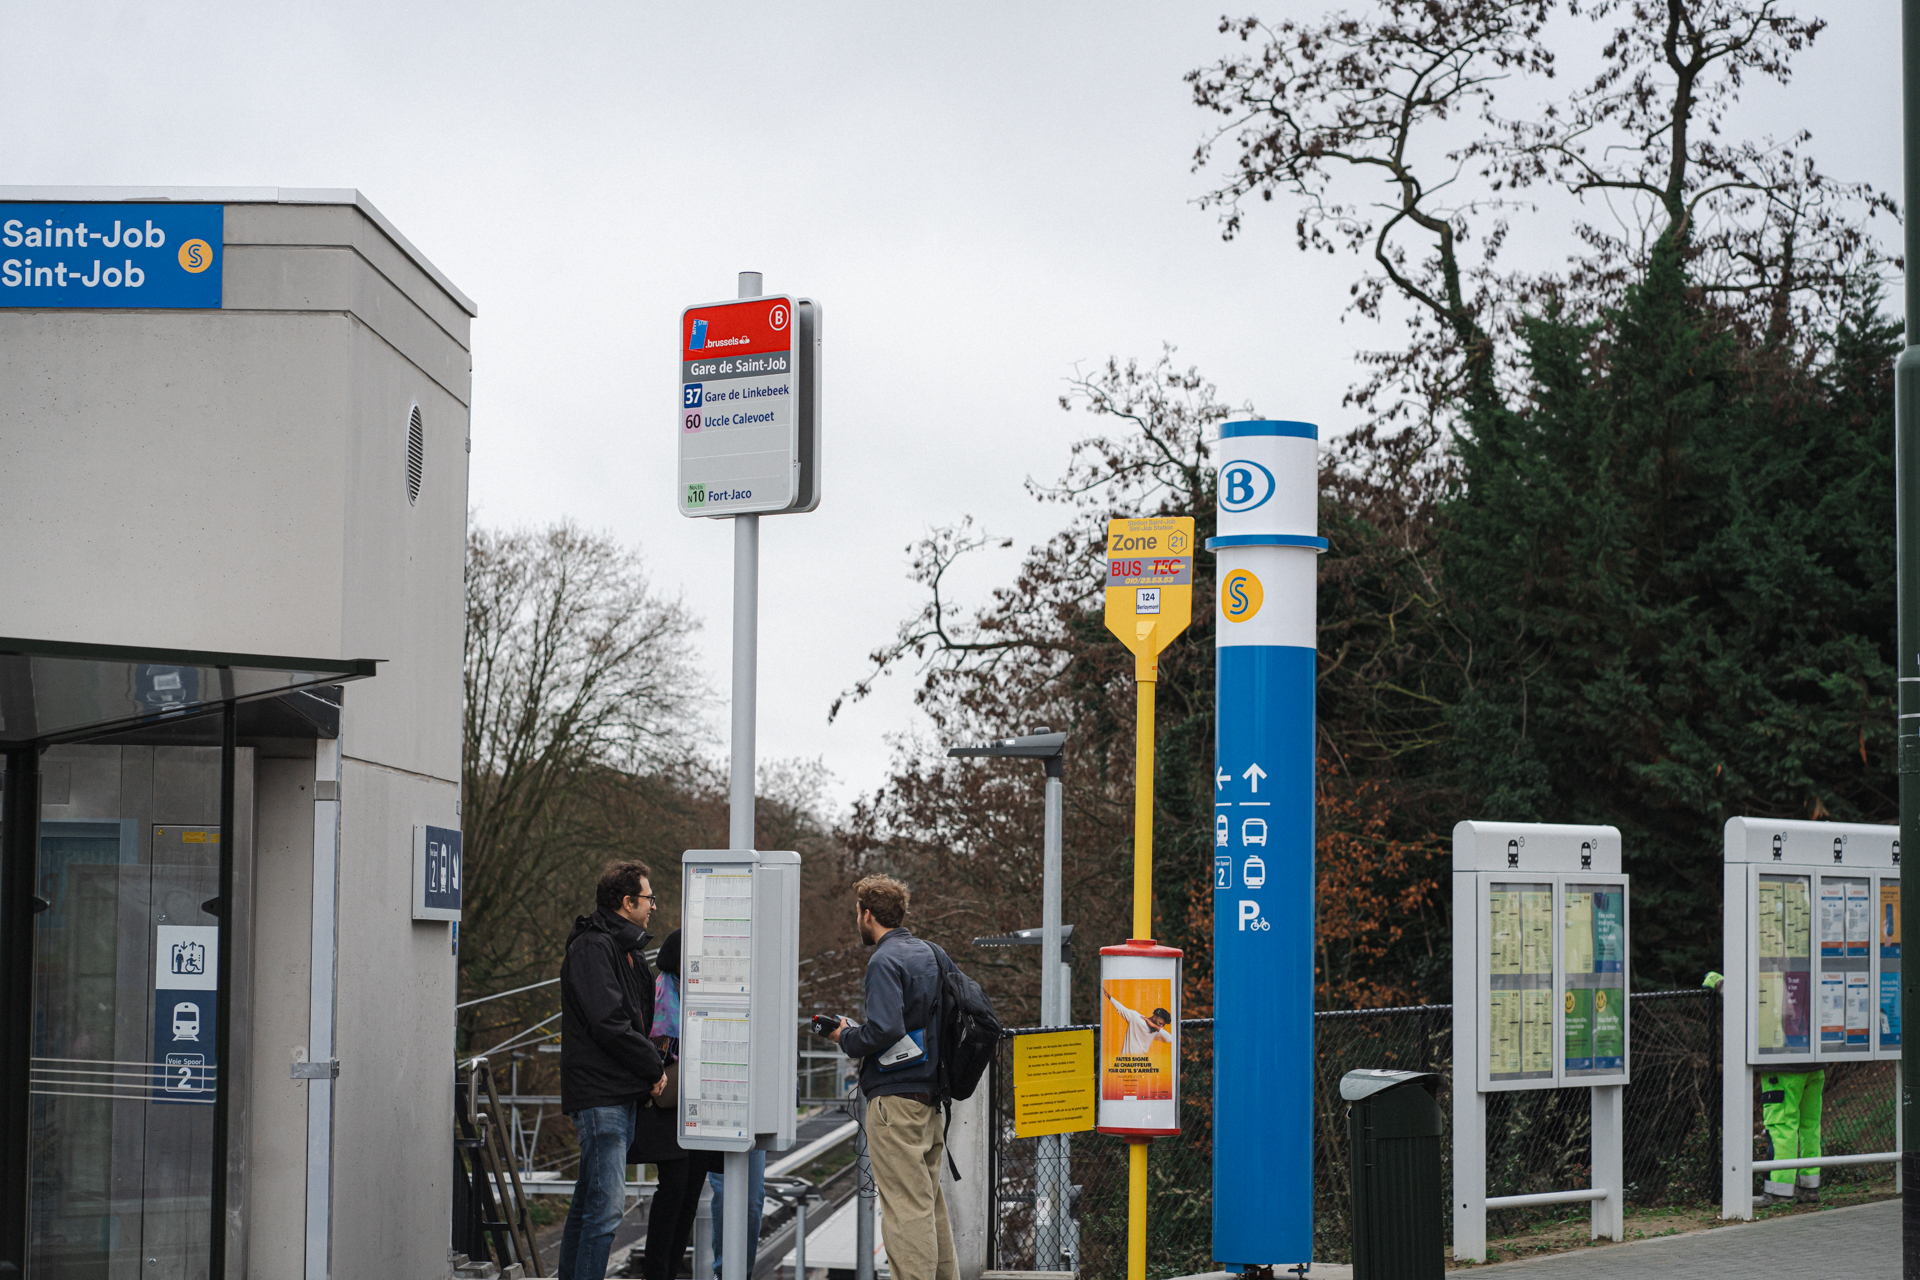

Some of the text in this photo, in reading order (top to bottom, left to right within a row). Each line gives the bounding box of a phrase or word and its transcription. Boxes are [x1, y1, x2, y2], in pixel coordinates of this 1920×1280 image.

[2, 219, 166, 248] Saint-Job
[1, 258, 145, 288] Sint-Job
[705, 336, 739, 349] .brussels
[690, 357, 787, 376] Gare de Saint-Job
[685, 387, 702, 405] 37
[704, 384, 790, 402] Gare de Linkebeek
[685, 413, 701, 429] 60
[704, 411, 775, 428] Uccle Calevoet
[688, 490, 705, 503] N10
[708, 489, 752, 502] Fort-Jaco
[1112, 534, 1157, 552] Zone
[1171, 536, 1184, 547] 21
[1111, 560, 1142, 577] BUS
[1153, 559, 1181, 575] TEC
[1142, 593, 1155, 601] 124
[1218, 868, 1225, 886] 2
[1238, 900, 1260, 932] P
[183, 1058, 202, 1066] Spoor
[178, 1067, 192, 1089] 2
